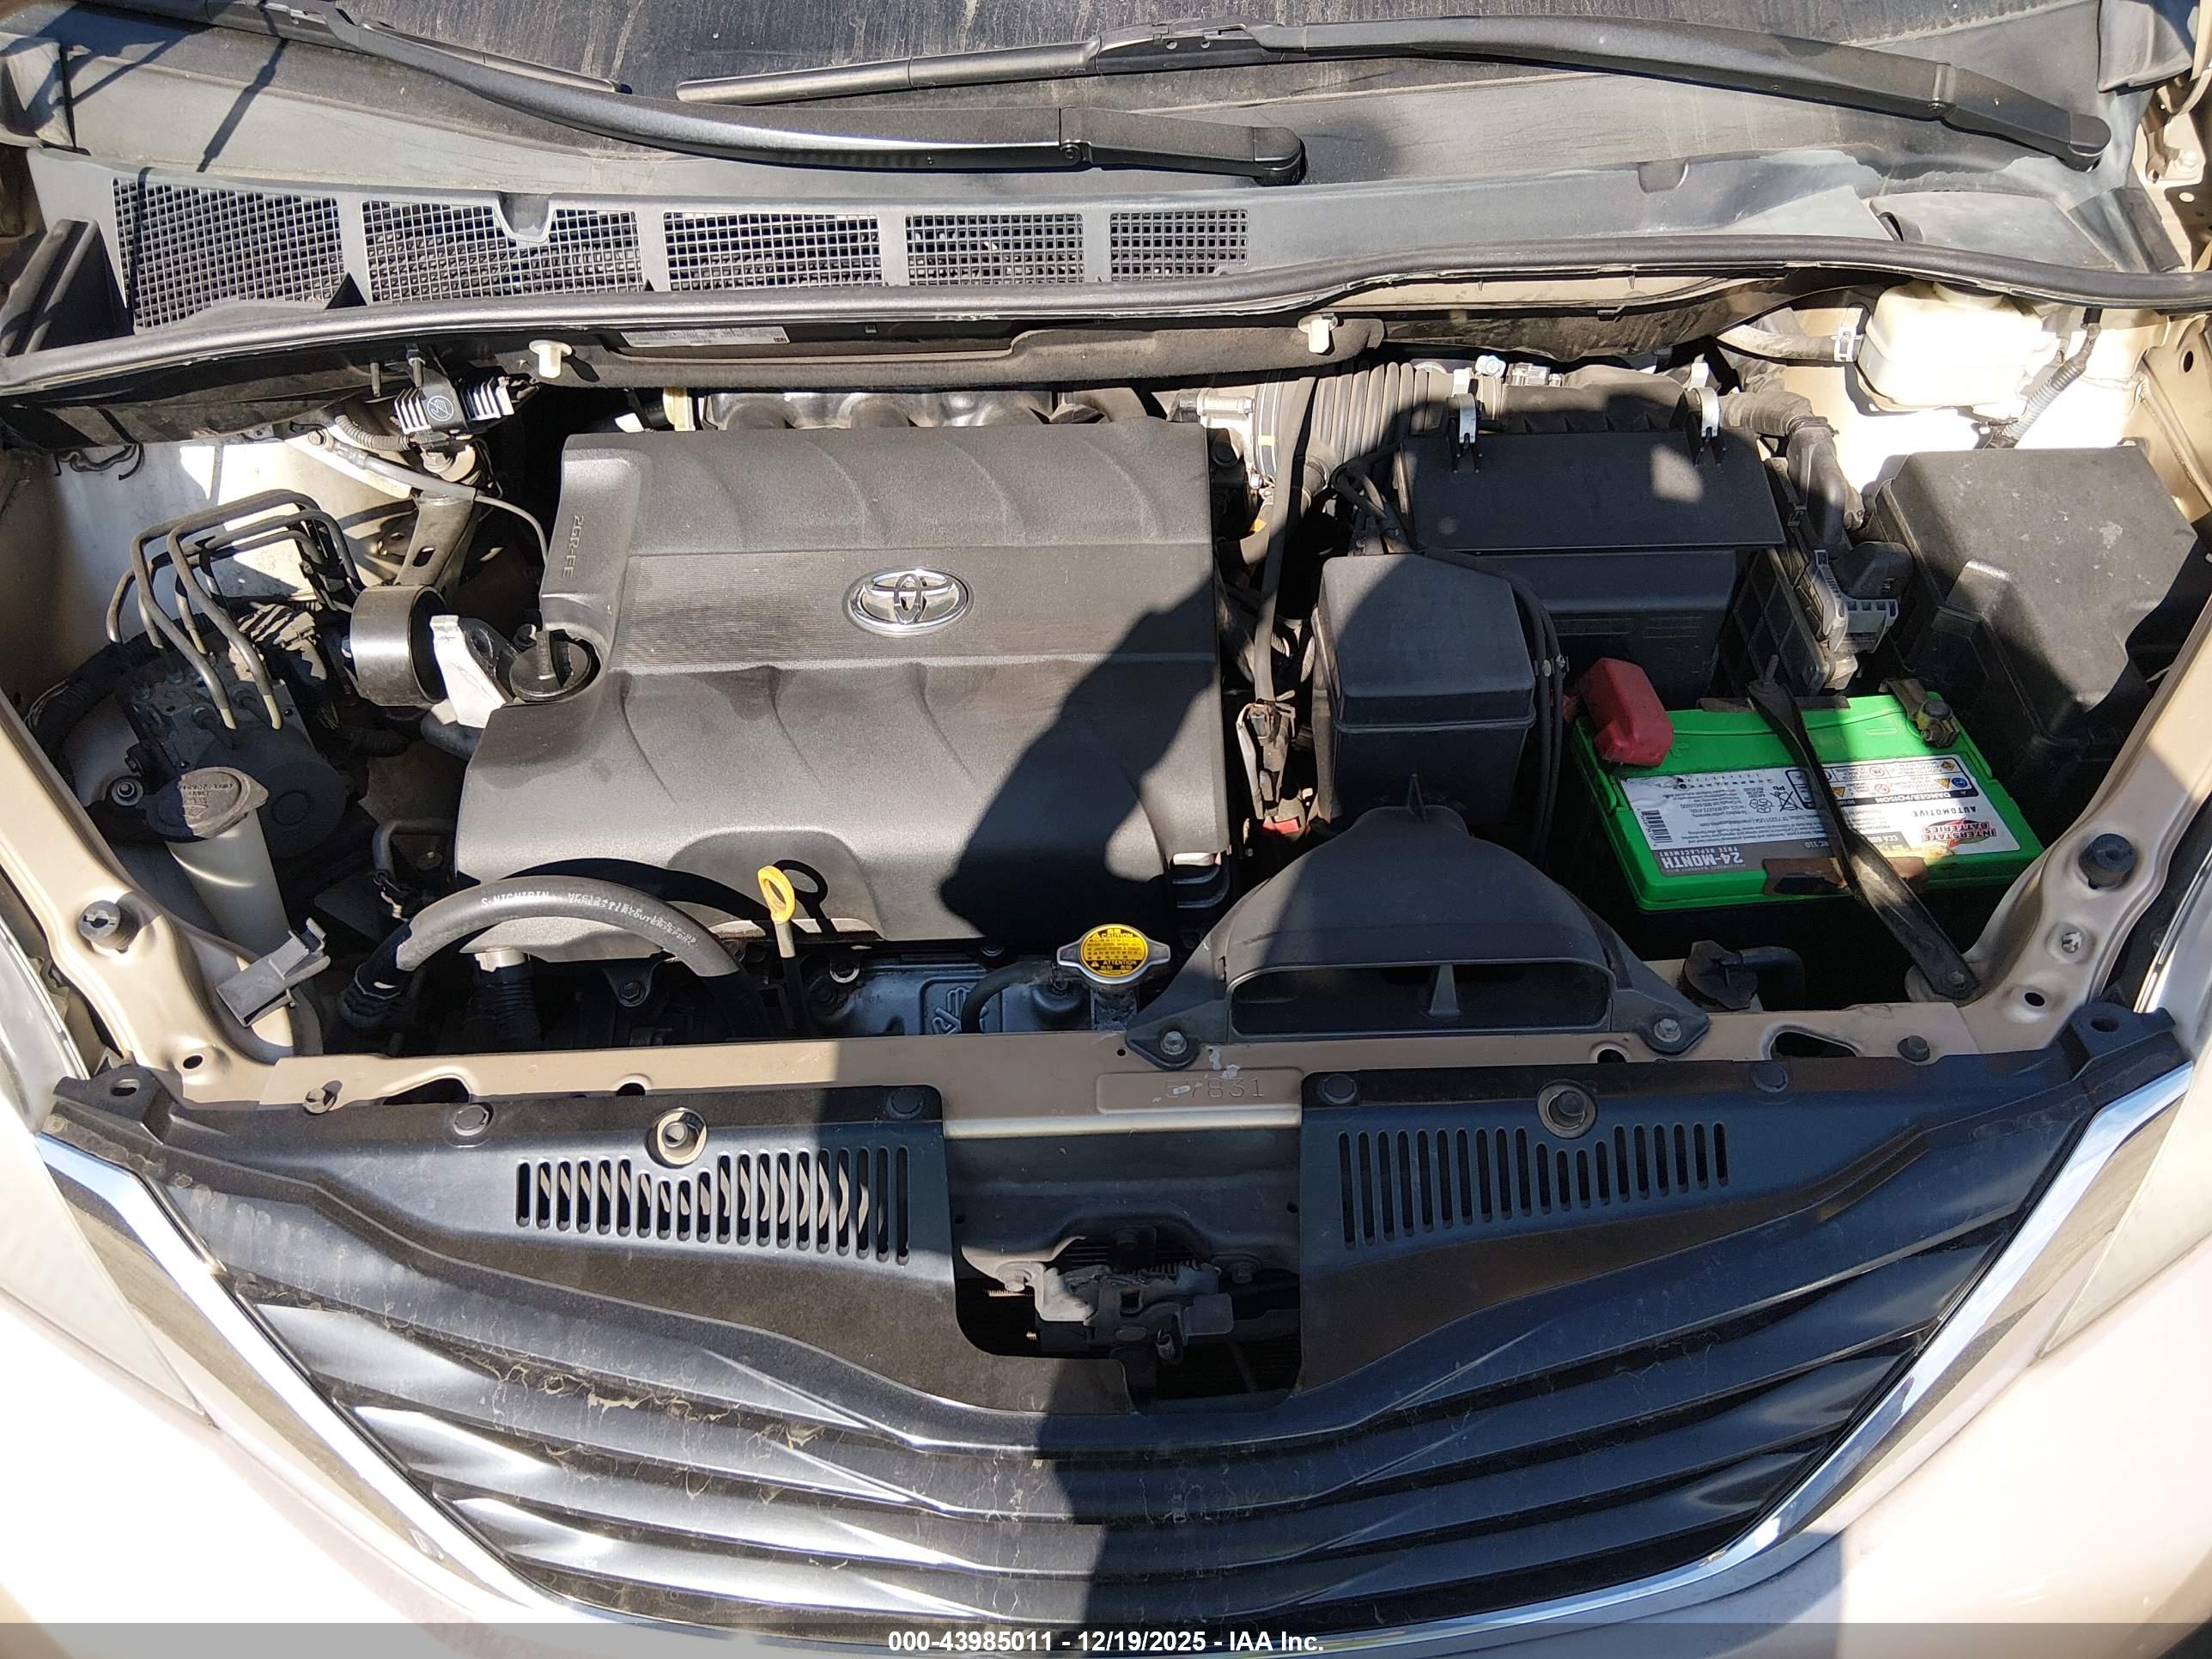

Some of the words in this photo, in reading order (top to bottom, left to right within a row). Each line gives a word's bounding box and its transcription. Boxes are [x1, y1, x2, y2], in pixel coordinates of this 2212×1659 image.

[562, 514, 584, 578] 2GR-FE
[1875, 791, 1952, 804] DANGER/POISON
[1913, 805, 1977, 817] AUTOMOTIVE
[1924, 822, 1990, 833] BATTERIES
[1923, 828, 1997, 842] INTERSTATE
[1659, 848, 1716, 857] REPLACEMENT
[1661, 852, 1744, 869] 24-MONTH
